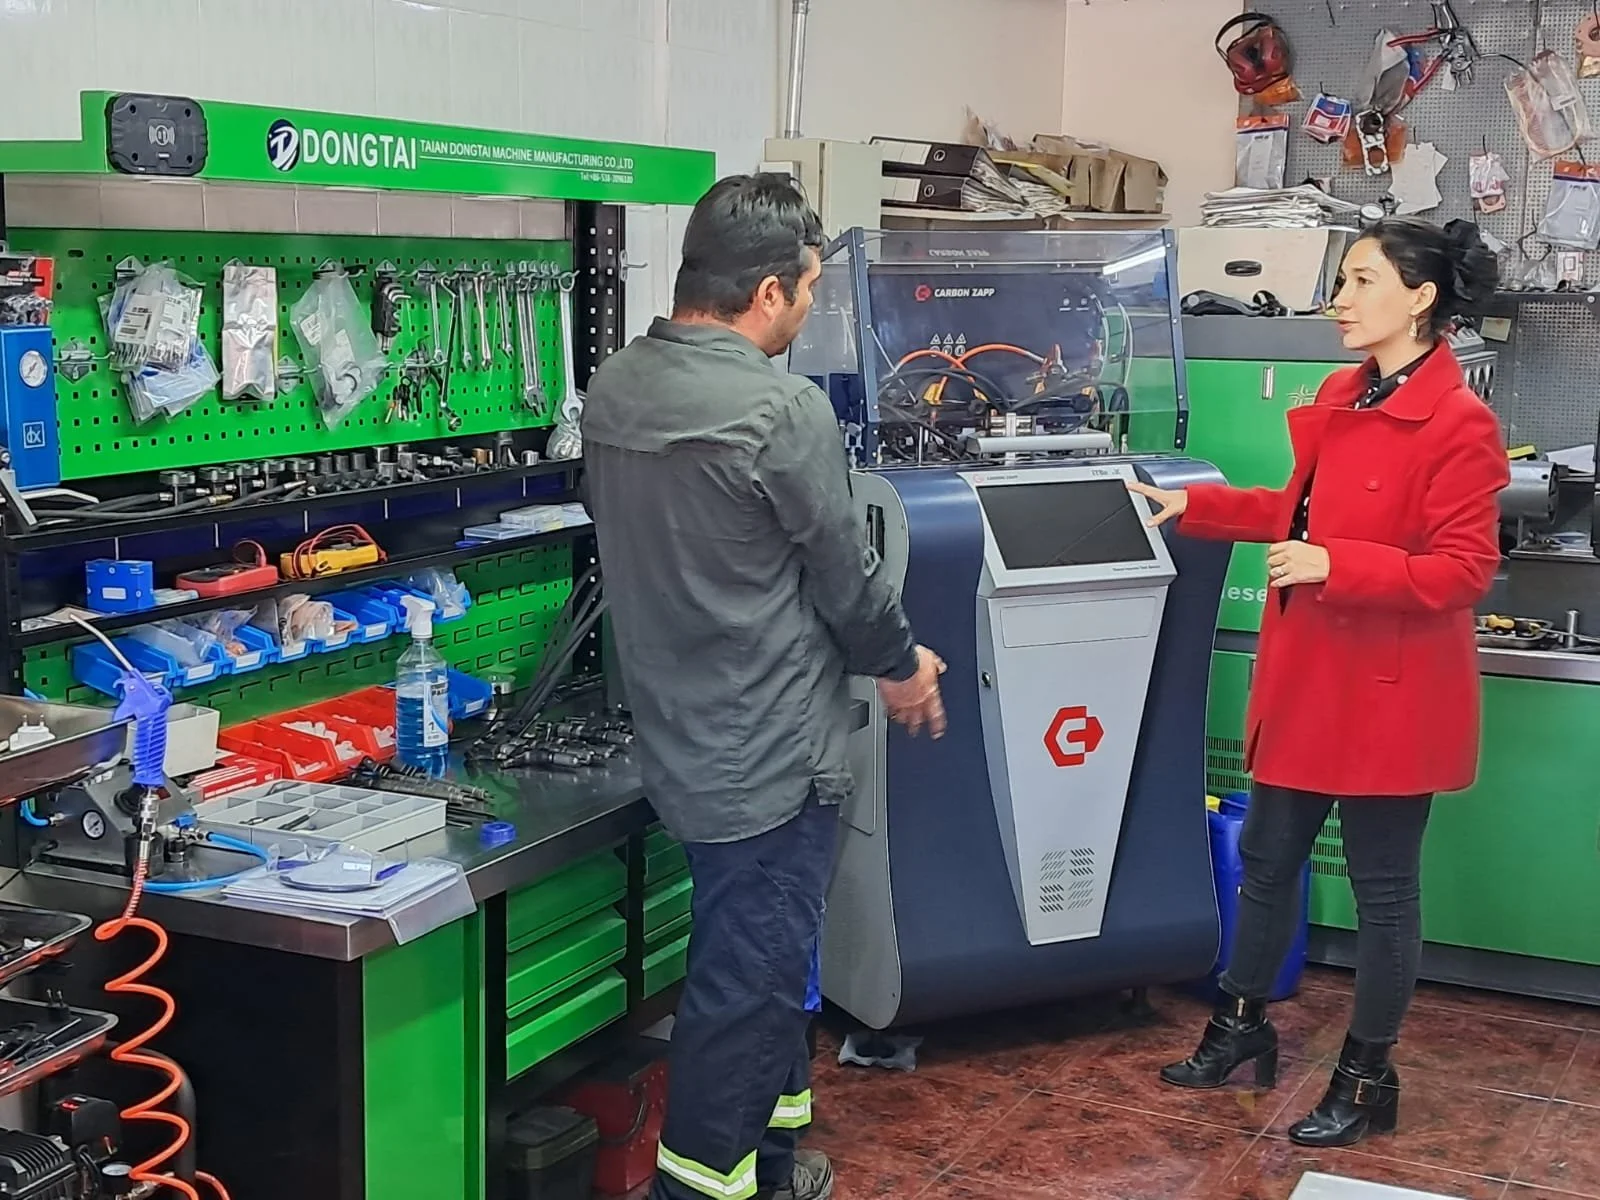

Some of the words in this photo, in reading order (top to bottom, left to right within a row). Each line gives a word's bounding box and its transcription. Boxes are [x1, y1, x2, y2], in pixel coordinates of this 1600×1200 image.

[302, 128, 417, 170] DONGTAI
[420, 139, 449, 155] TAIAN
[449, 142, 492, 159] DONGTAI
[492, 146, 533, 162] MACHINE
[533, 149, 604, 168] MANUFACTURING
[934, 288, 970, 297] CARBON
[971, 288, 995, 297] ZAPP
